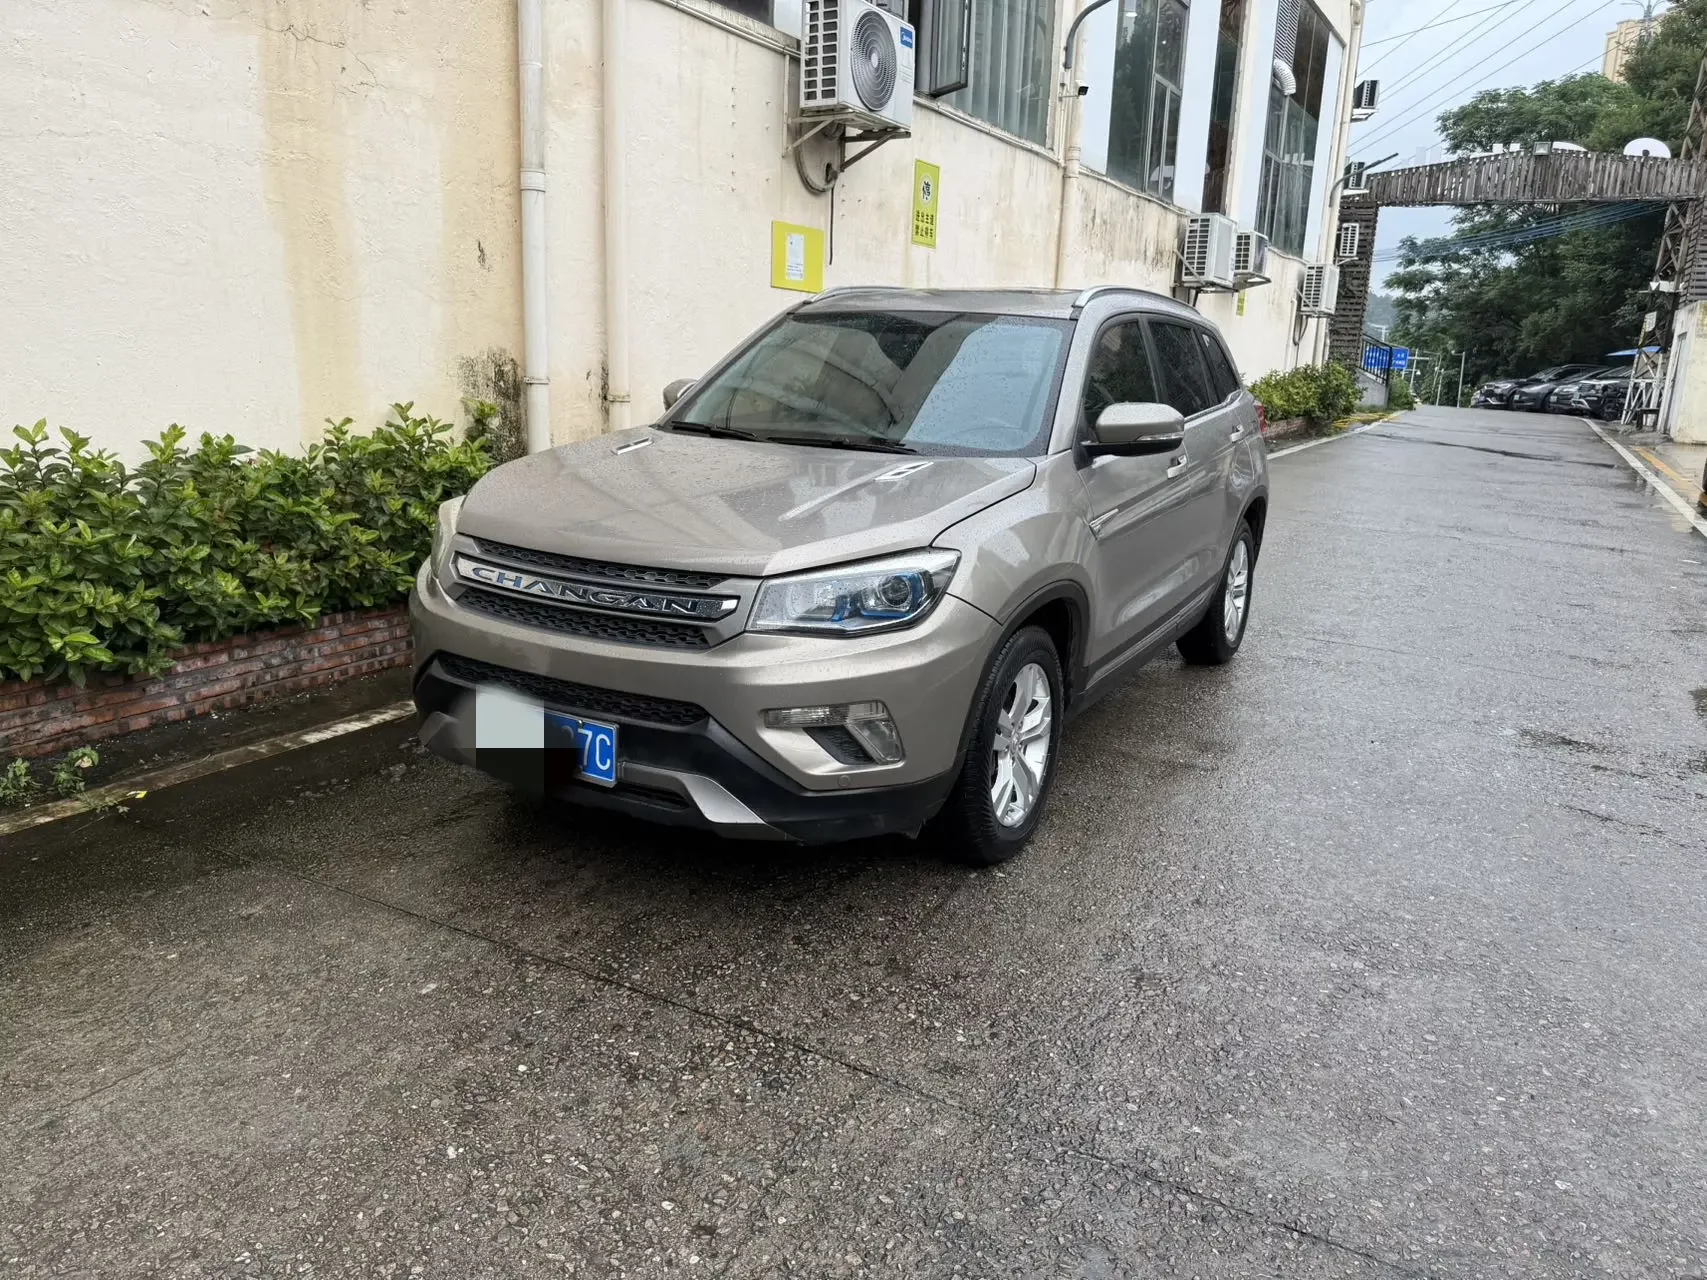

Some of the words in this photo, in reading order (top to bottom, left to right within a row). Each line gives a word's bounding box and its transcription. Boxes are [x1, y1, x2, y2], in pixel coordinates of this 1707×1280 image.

[915, 225, 933, 237] 禁止停车
[472, 566, 699, 614] CHANGAN
